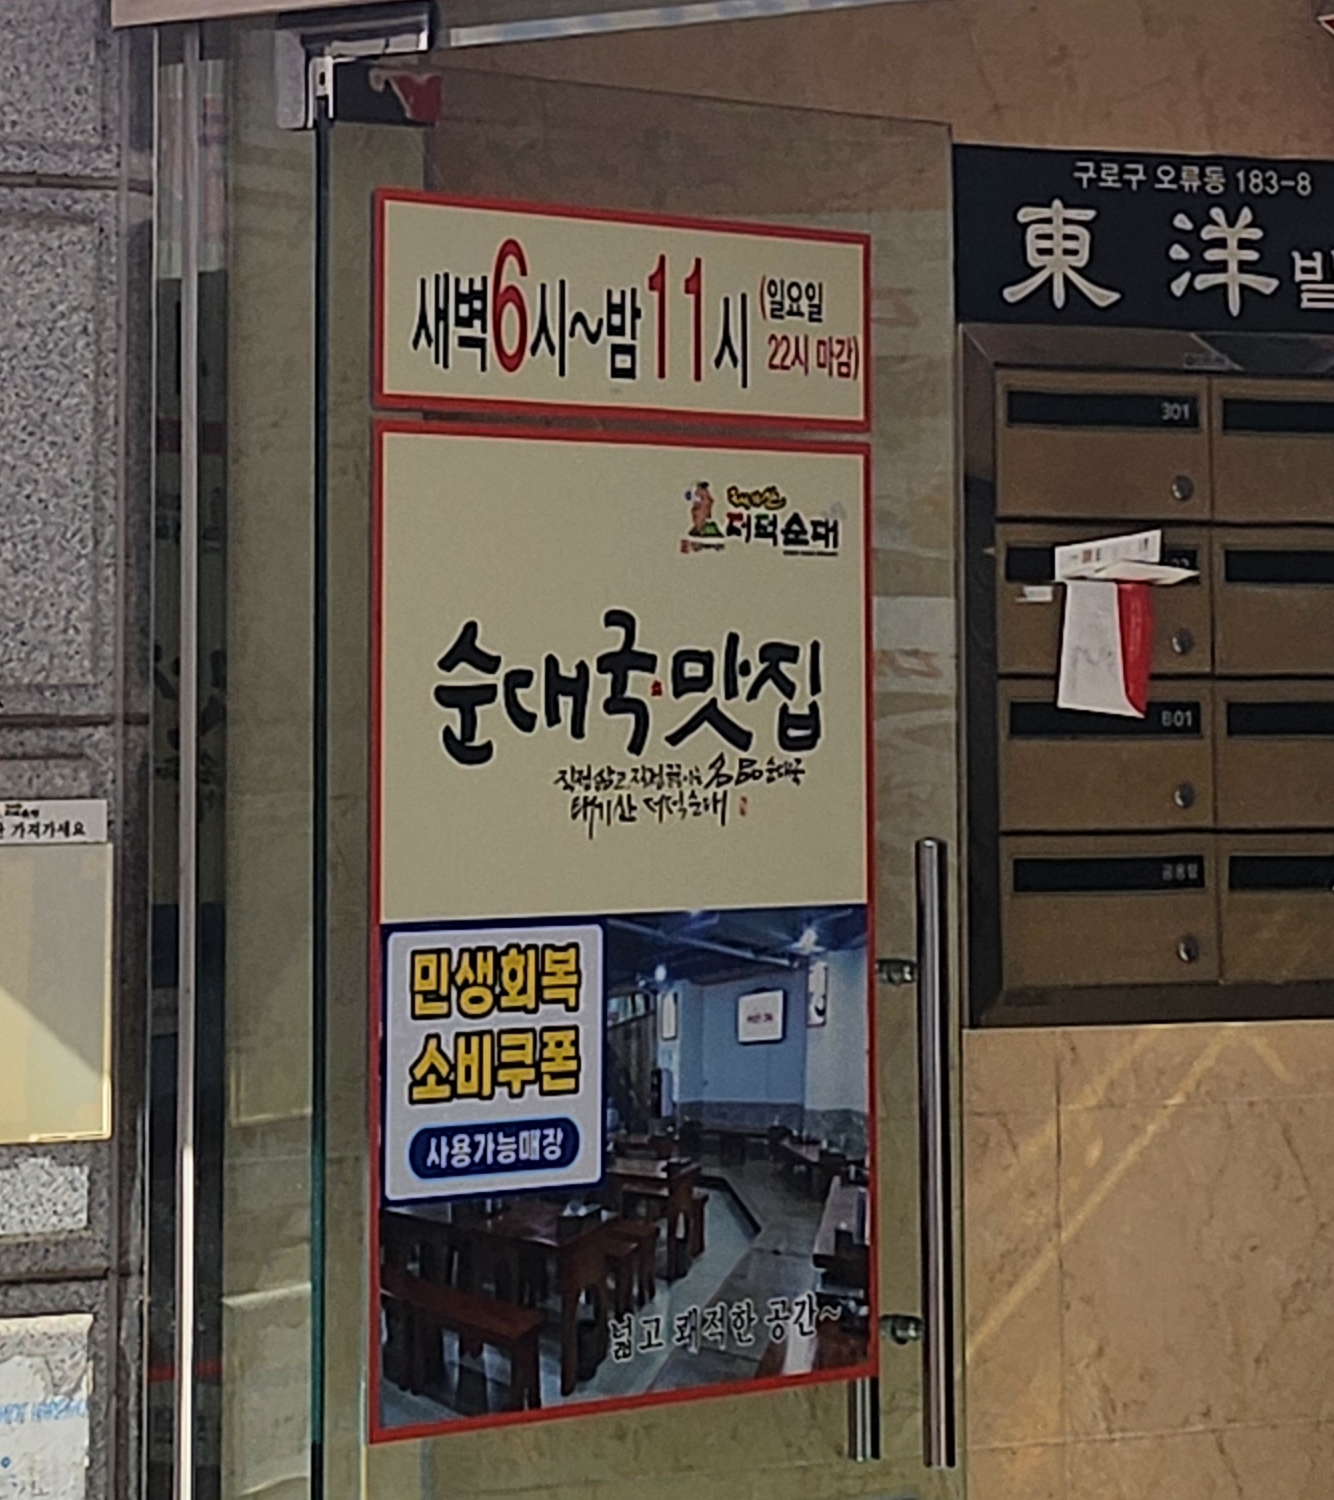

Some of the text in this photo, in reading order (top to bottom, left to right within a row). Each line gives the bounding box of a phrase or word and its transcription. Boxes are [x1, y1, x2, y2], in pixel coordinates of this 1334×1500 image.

[1073, 161, 1313, 197] 구로구 오류동 183-8
[759, 274, 824, 324] (일요일
[767, 334, 860, 382] 22시 마감)
[1160, 402, 1190, 421] 301
[726, 512, 840, 549] 더덕순대
[11, 819, 87, 840] 가져가세요
[410, 942, 581, 1020] 민생회복
[408, 1025, 581, 1106] 소비쿠폰
[425, 1126, 565, 1170] 사용가능매장
[610, 1314, 664, 1362] 넓고
[674, 1299, 757, 1351] 쾌적한
